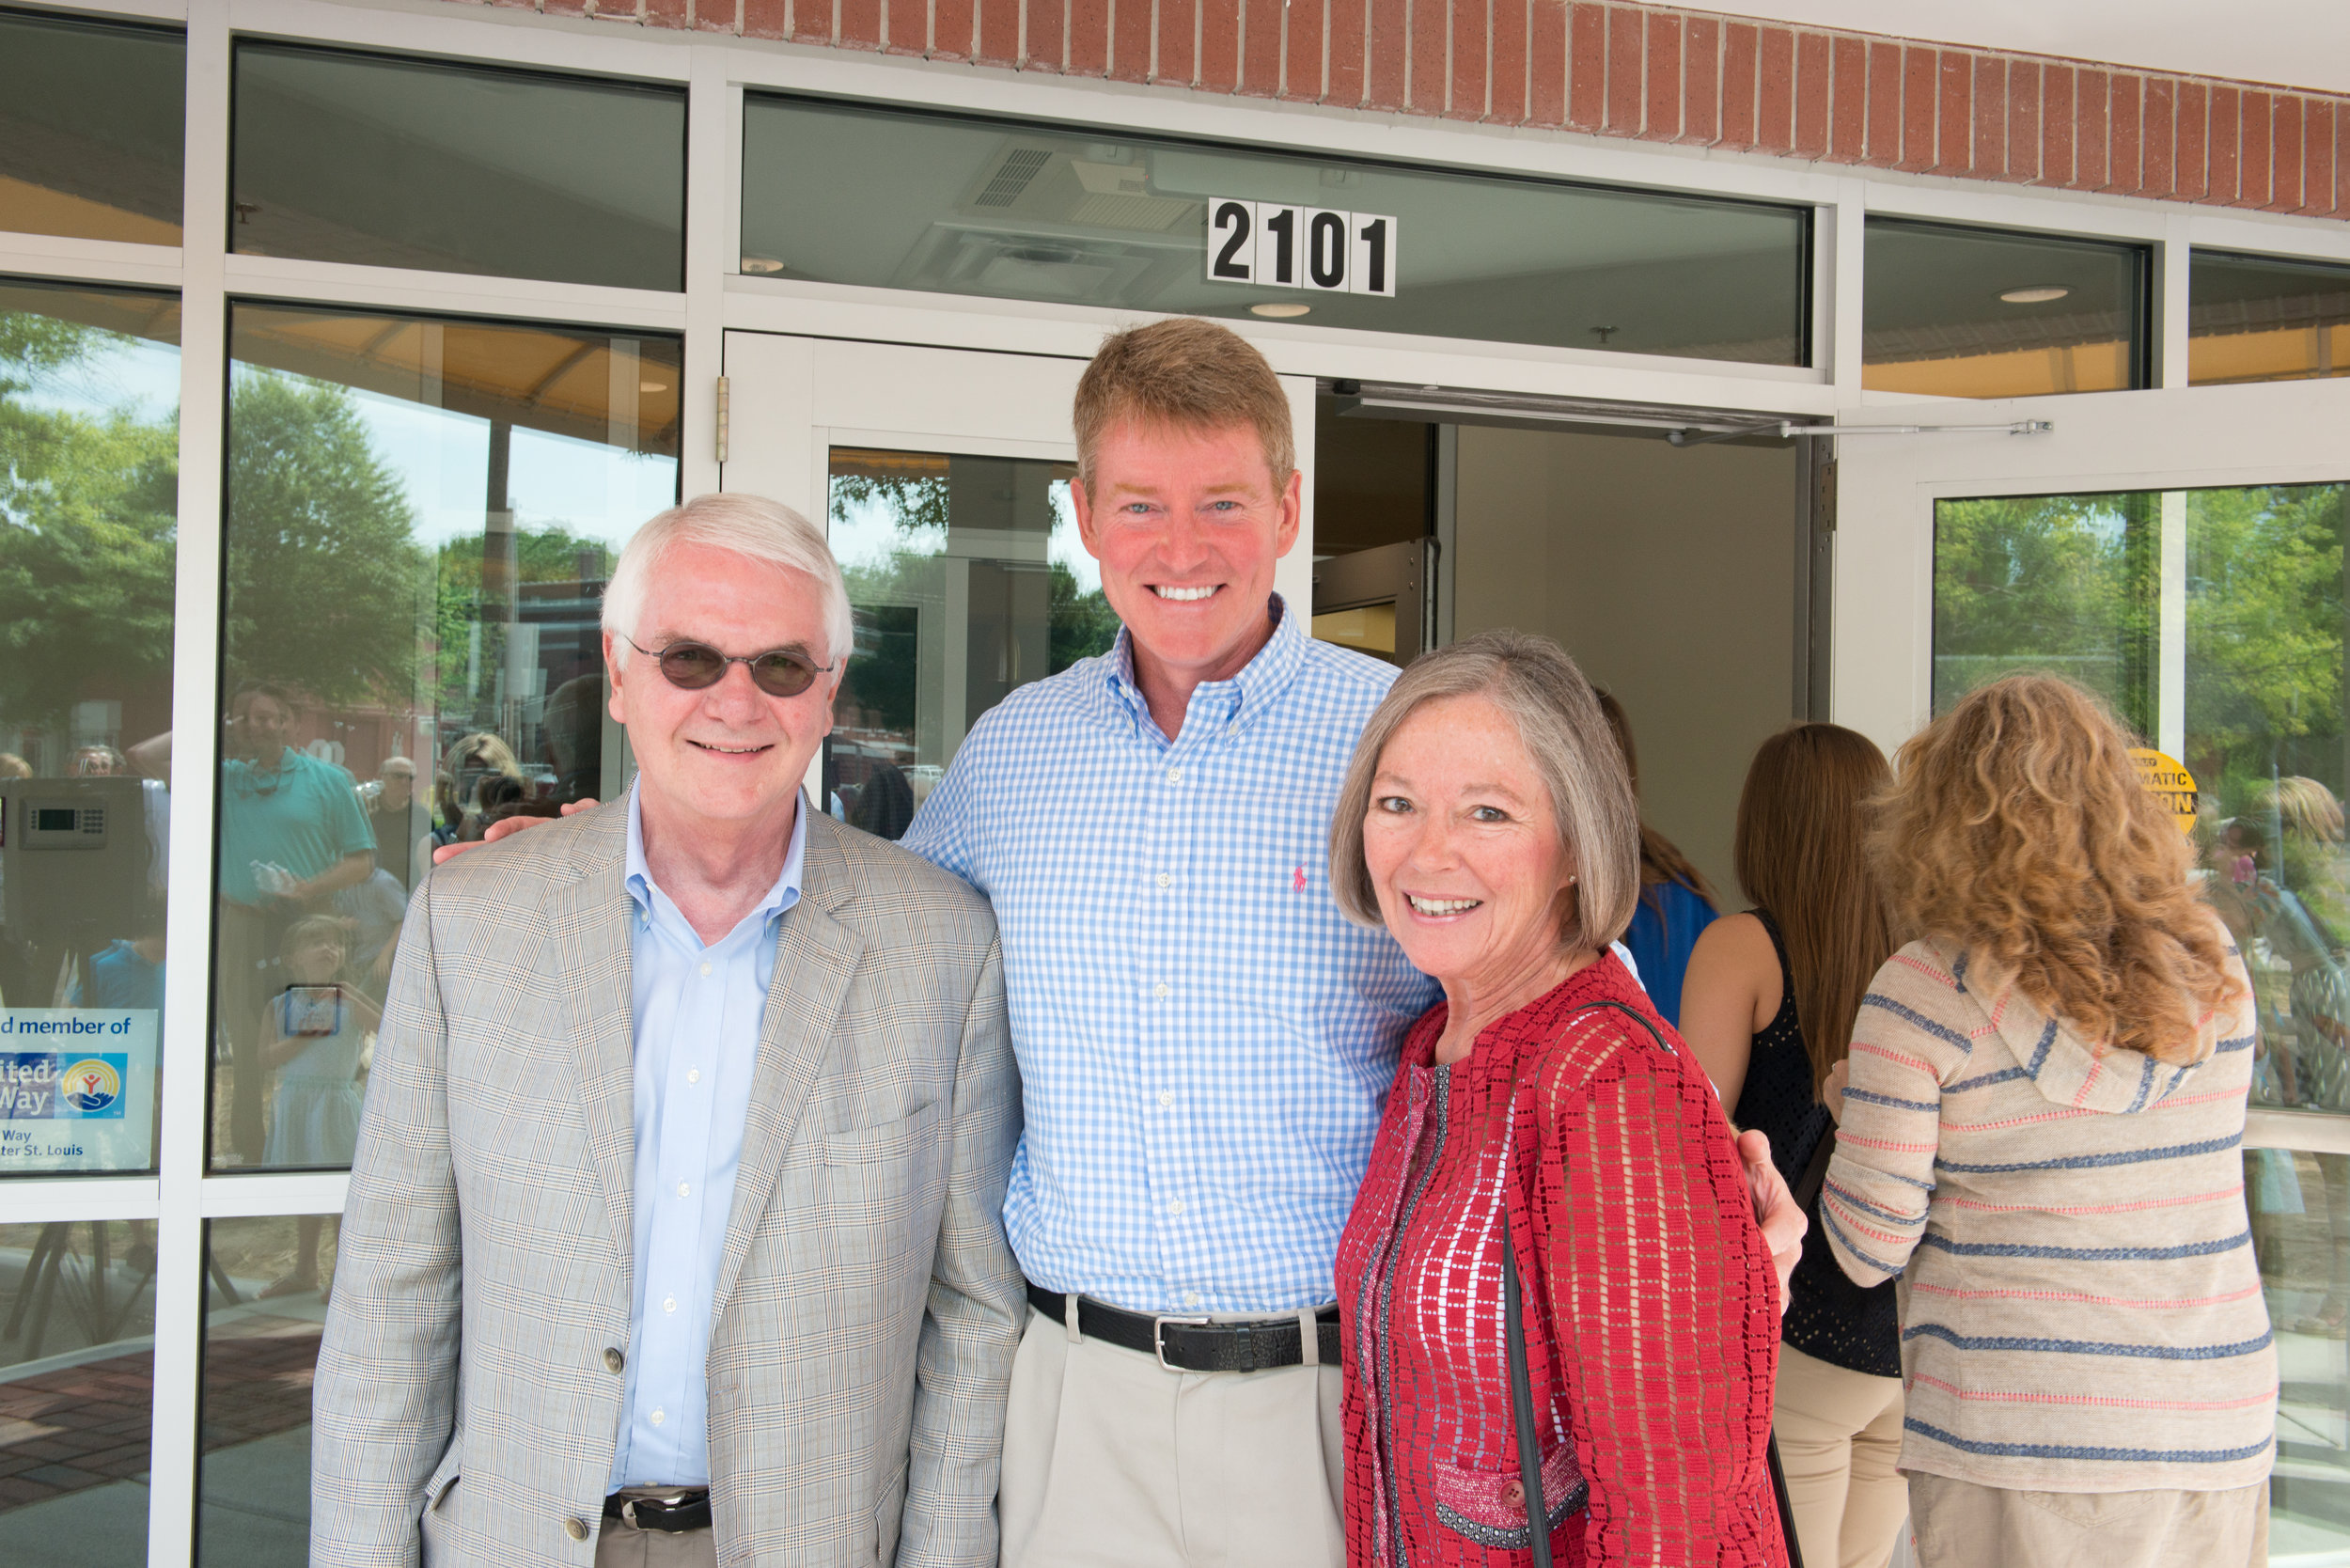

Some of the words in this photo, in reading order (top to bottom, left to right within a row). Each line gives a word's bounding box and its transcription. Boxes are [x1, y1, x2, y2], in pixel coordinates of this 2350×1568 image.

[1214, 202, 1386, 292] 2101
[2139, 773, 2187, 786] MATIC
[20, 1017, 105, 1034] member
[111, 1017, 132, 1034] of
[0, 1059, 50, 1083] ited
[0, 1086, 49, 1116] Way
[3, 1130, 32, 1143] Way
[24, 1144, 42, 1156] St.
[47, 1144, 84, 1156] Louis
